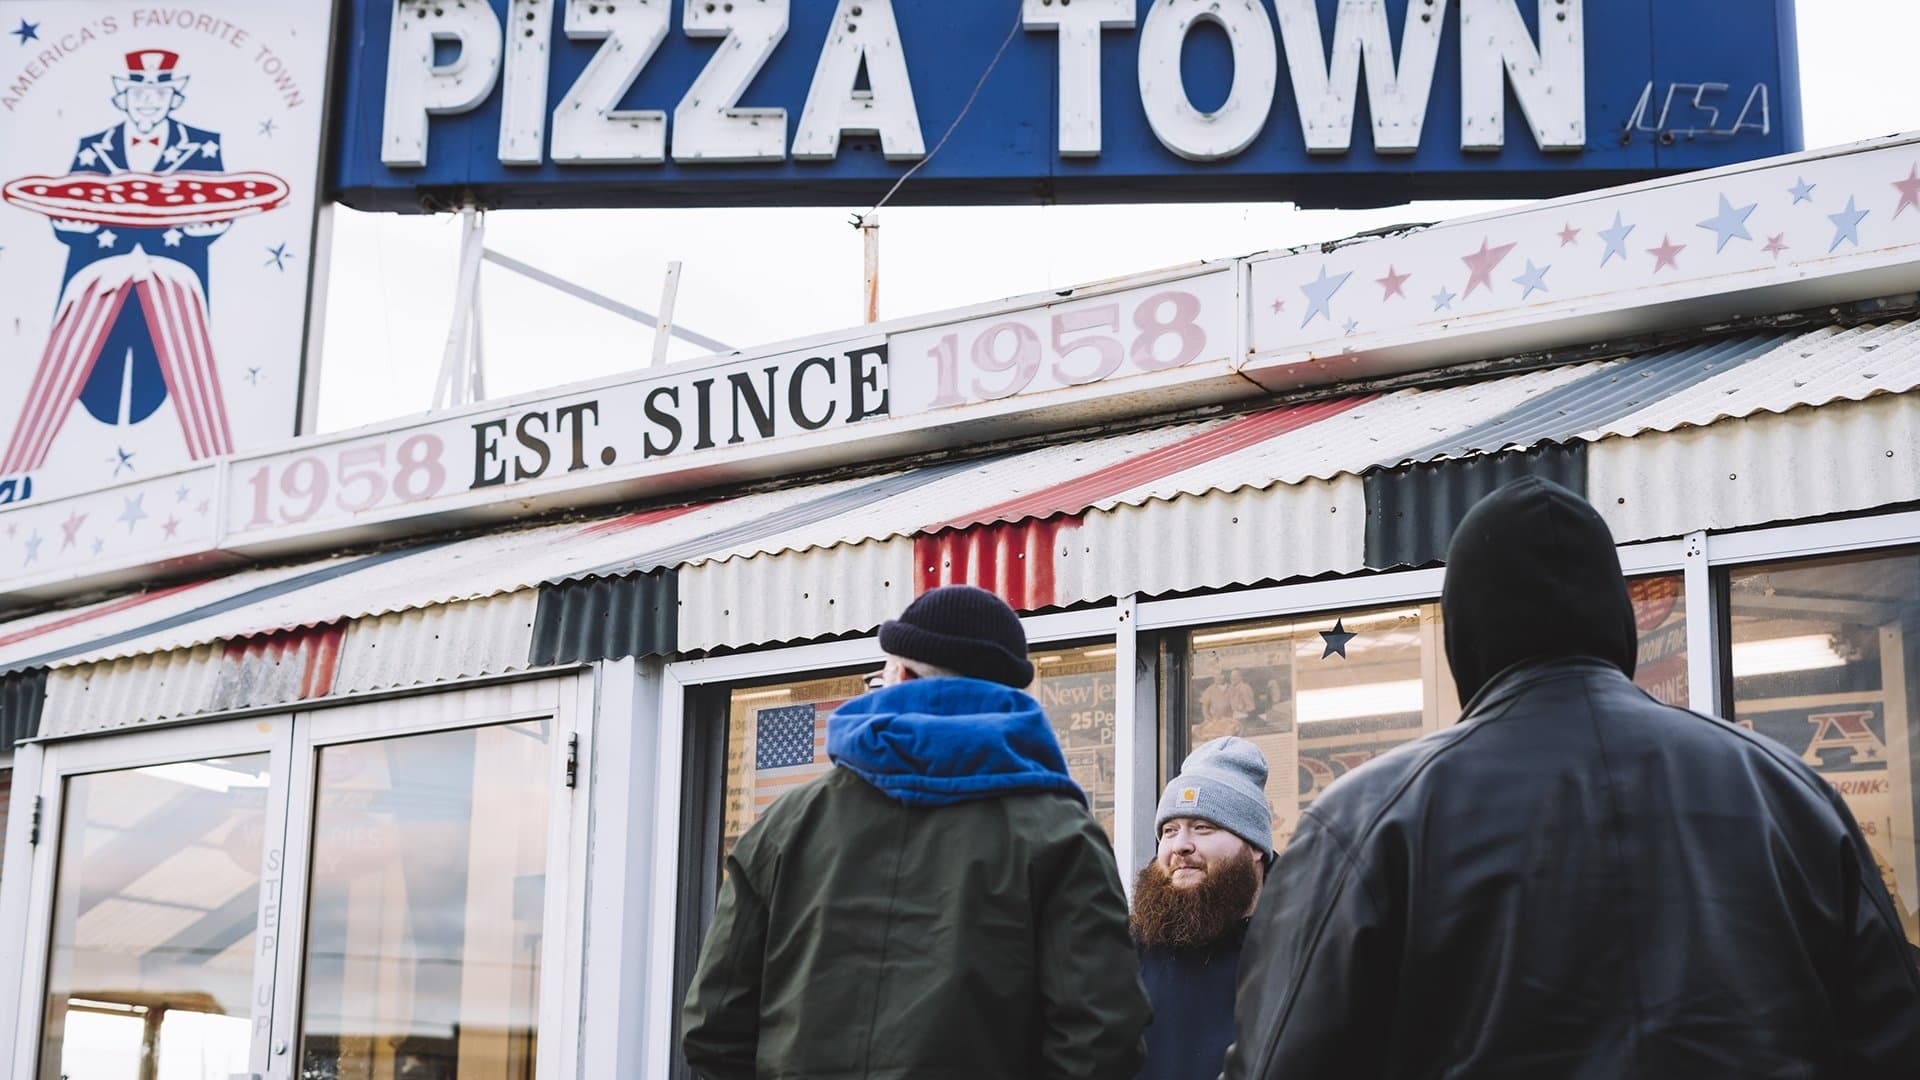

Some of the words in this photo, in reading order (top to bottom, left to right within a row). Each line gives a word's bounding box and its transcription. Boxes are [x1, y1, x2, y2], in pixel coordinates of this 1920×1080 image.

[2, 16, 118, 111] AMERICA'S
[132, 8, 250, 49] FAVORITE
[254, 45, 304, 109] TOWN
[381, 0, 926, 167] PIZZA
[1022, 0, 1587, 163] TOWN
[247, 431, 447, 528] 1958
[469, 400, 617, 490] EST.
[642, 343, 889, 459] SINCE
[927, 290, 1208, 409] 1958
[1041, 680, 1092, 708] New
[1069, 711, 1093, 731] 25
[261, 849, 281, 956] STEP
[256, 985, 273, 1036] UP
